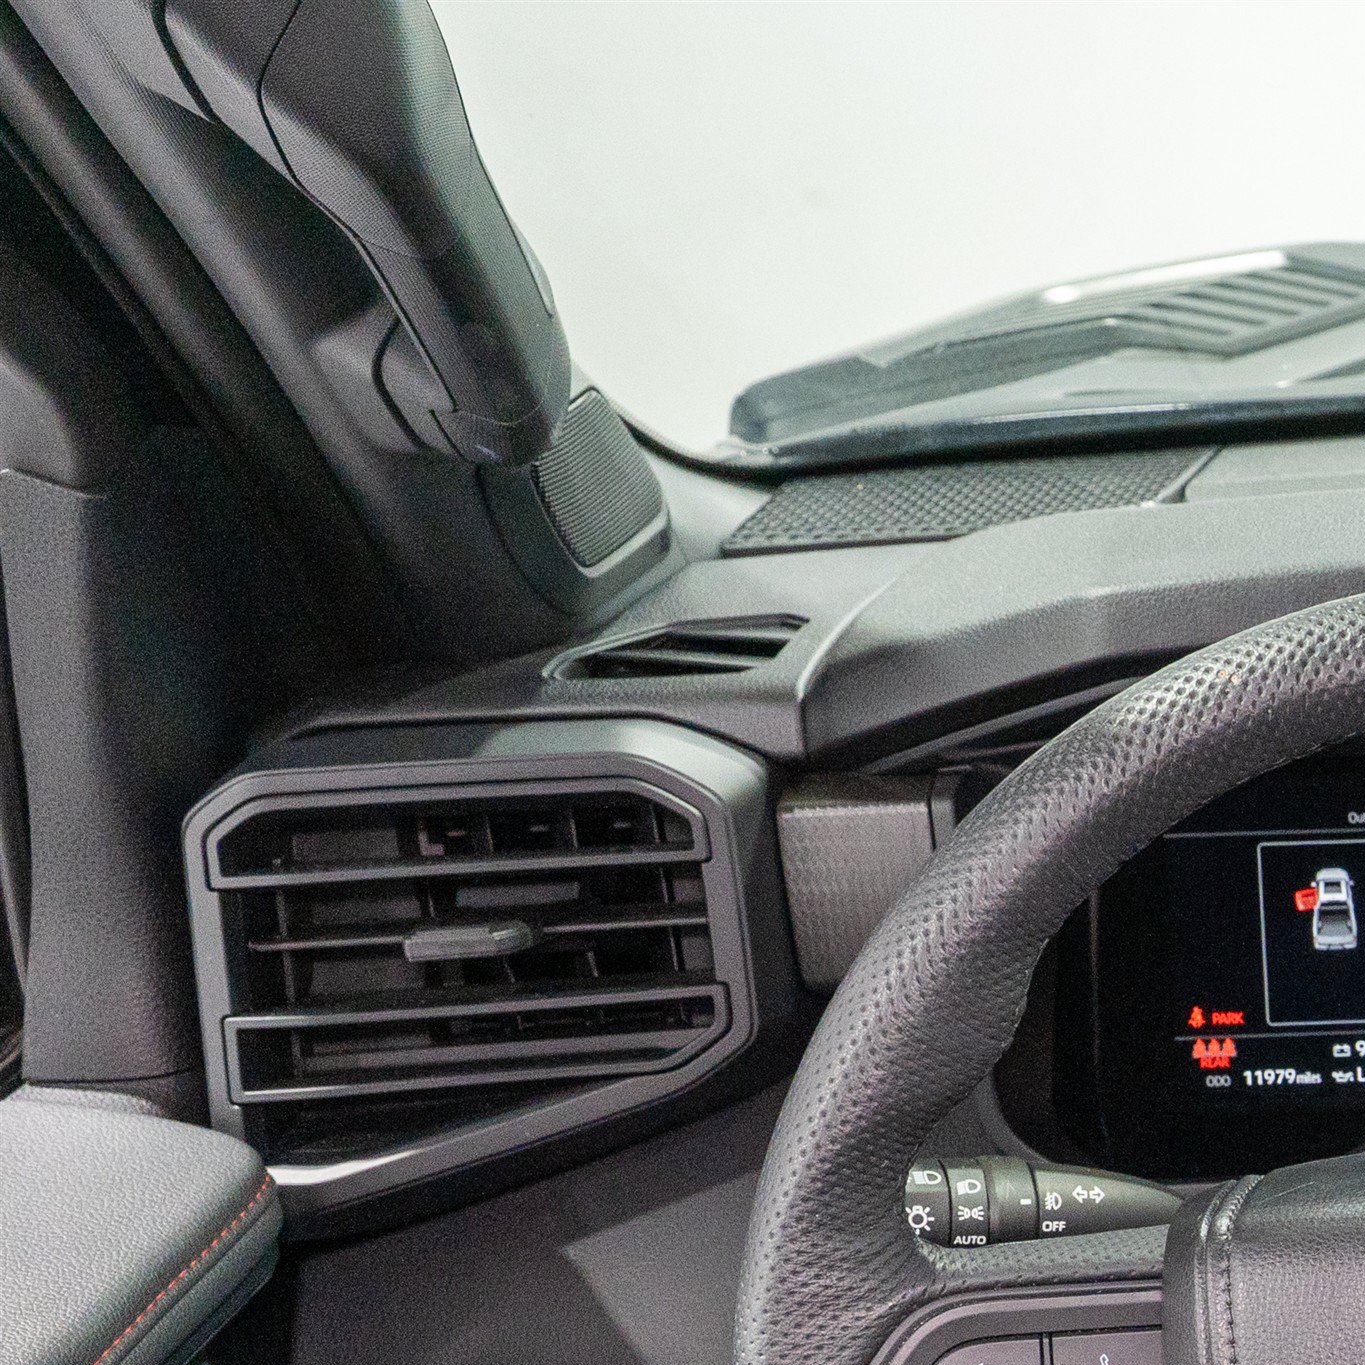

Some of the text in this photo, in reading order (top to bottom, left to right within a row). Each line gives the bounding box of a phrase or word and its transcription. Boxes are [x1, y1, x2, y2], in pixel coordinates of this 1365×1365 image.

[1212, 1011, 1245, 1026] PARK
[1042, 1220, 1067, 1233] OFF
[954, 1235, 987, 1246] AUTO
